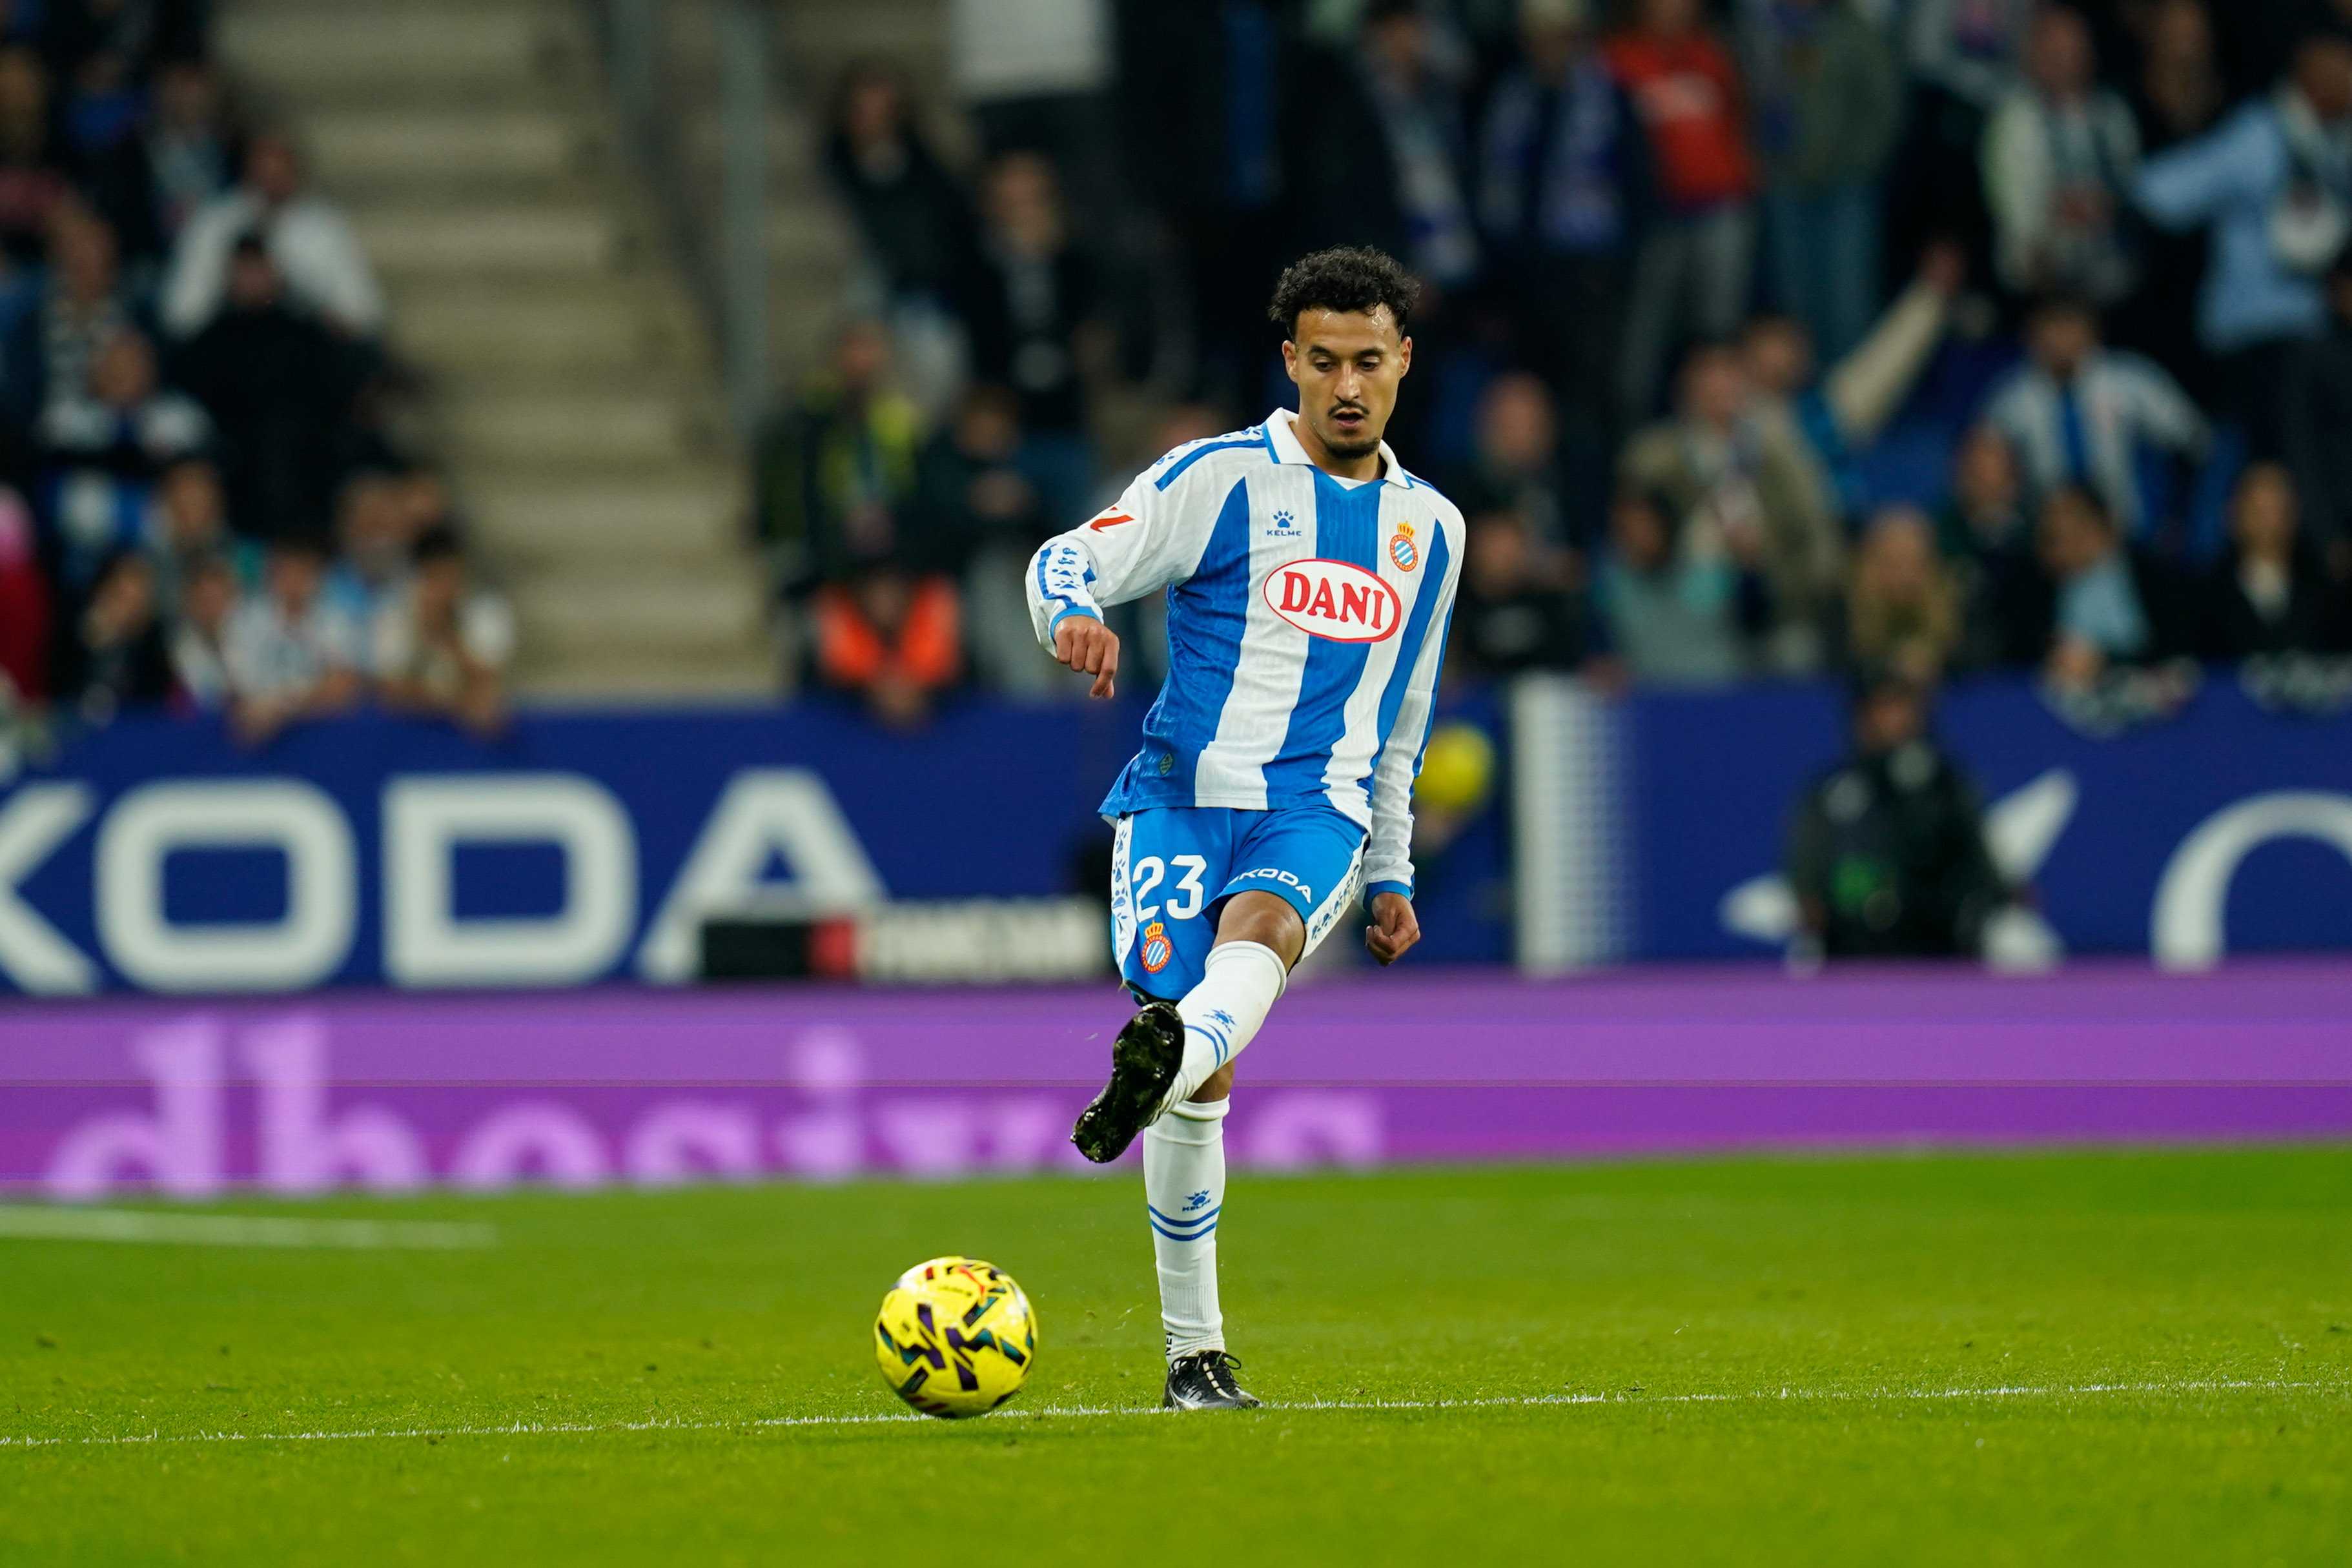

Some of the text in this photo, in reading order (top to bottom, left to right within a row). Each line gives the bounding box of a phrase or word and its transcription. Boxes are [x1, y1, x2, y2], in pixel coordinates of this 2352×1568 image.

[1280, 571, 1385, 629] DANI
[1132, 855, 1207, 923] 23
[1227, 868, 1312, 904] KODA
